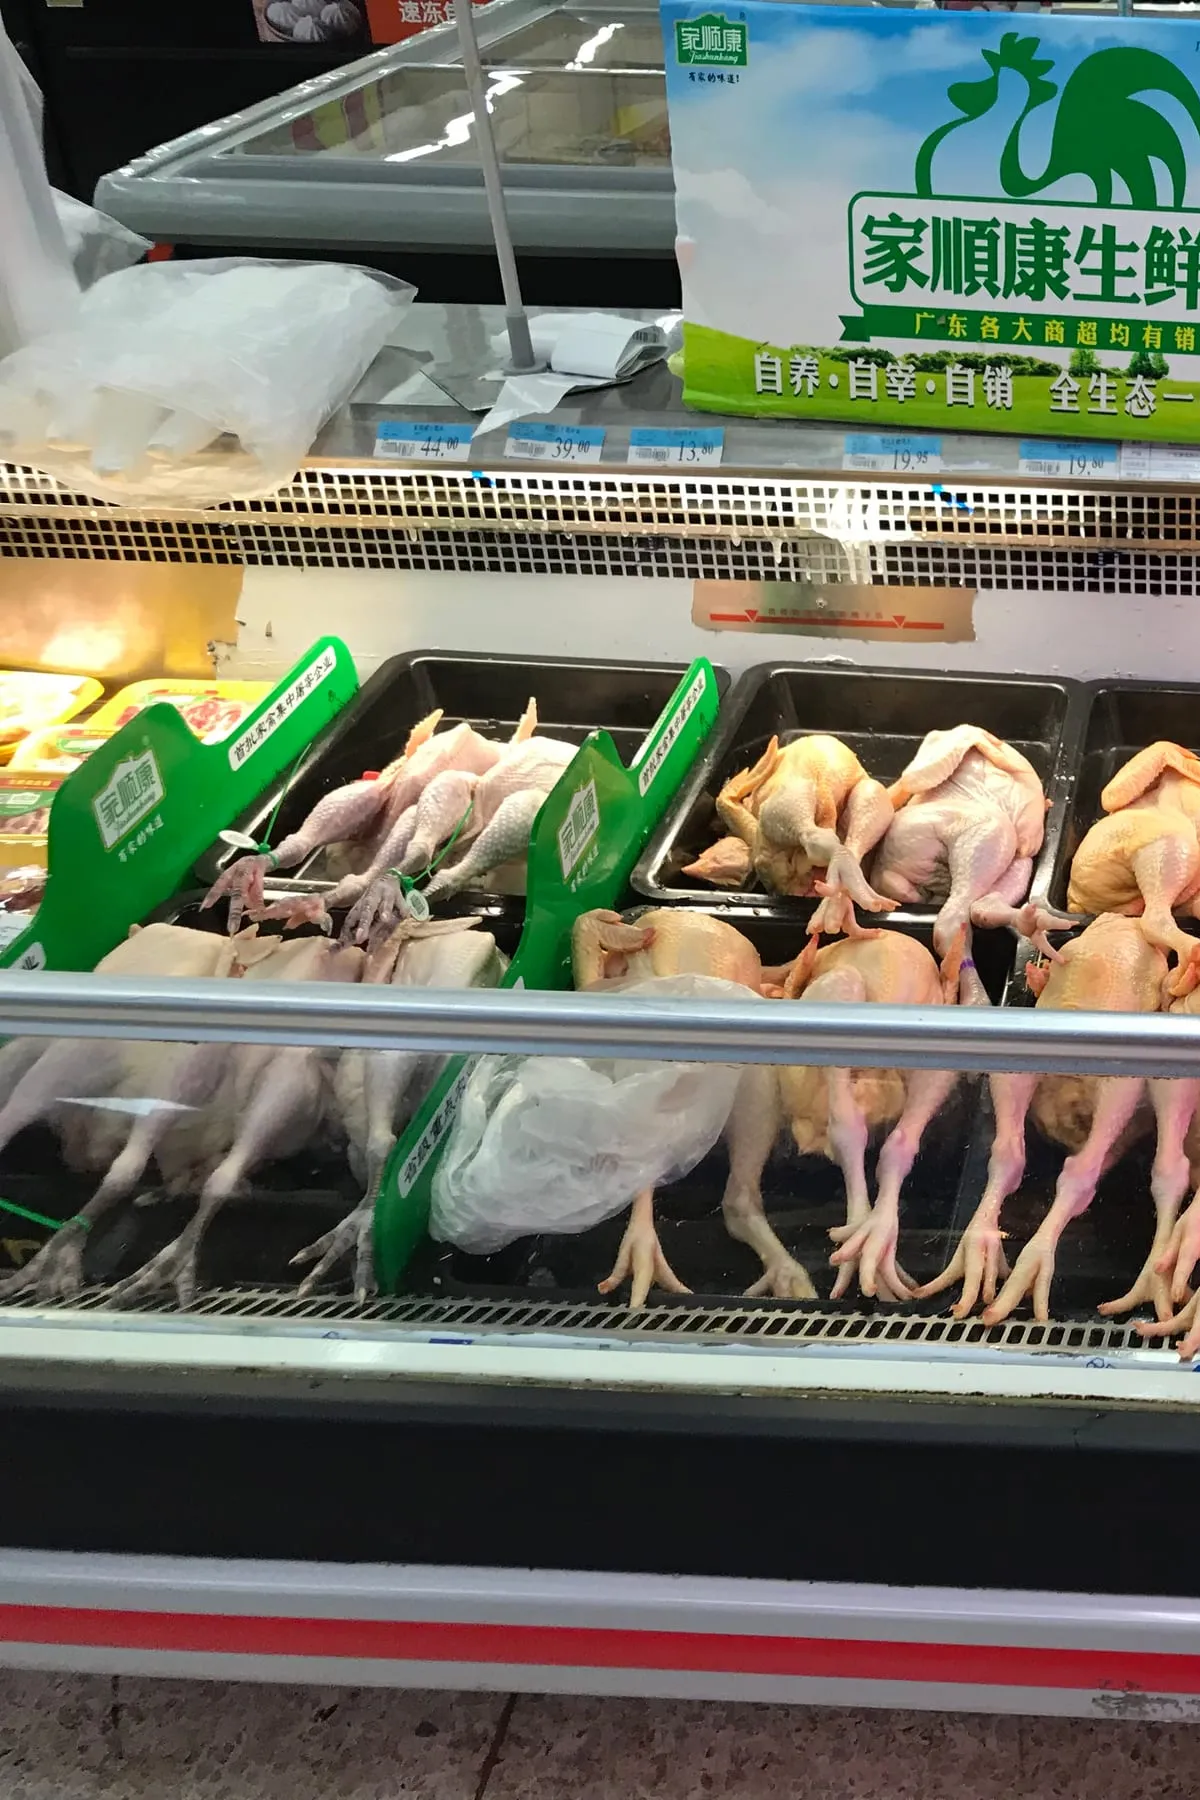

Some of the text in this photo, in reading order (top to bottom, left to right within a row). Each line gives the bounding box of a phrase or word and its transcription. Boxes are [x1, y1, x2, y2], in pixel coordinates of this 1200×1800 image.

[420, 436, 459, 457] 44.00
[552, 437, 590, 459] 39.00
[678, 441, 713, 461] 13.80
[893, 450, 928, 470] 19.95
[1069, 454, 1104, 475] 19.80
[234, 656, 333, 762] 首批家禽集中屠宰企业
